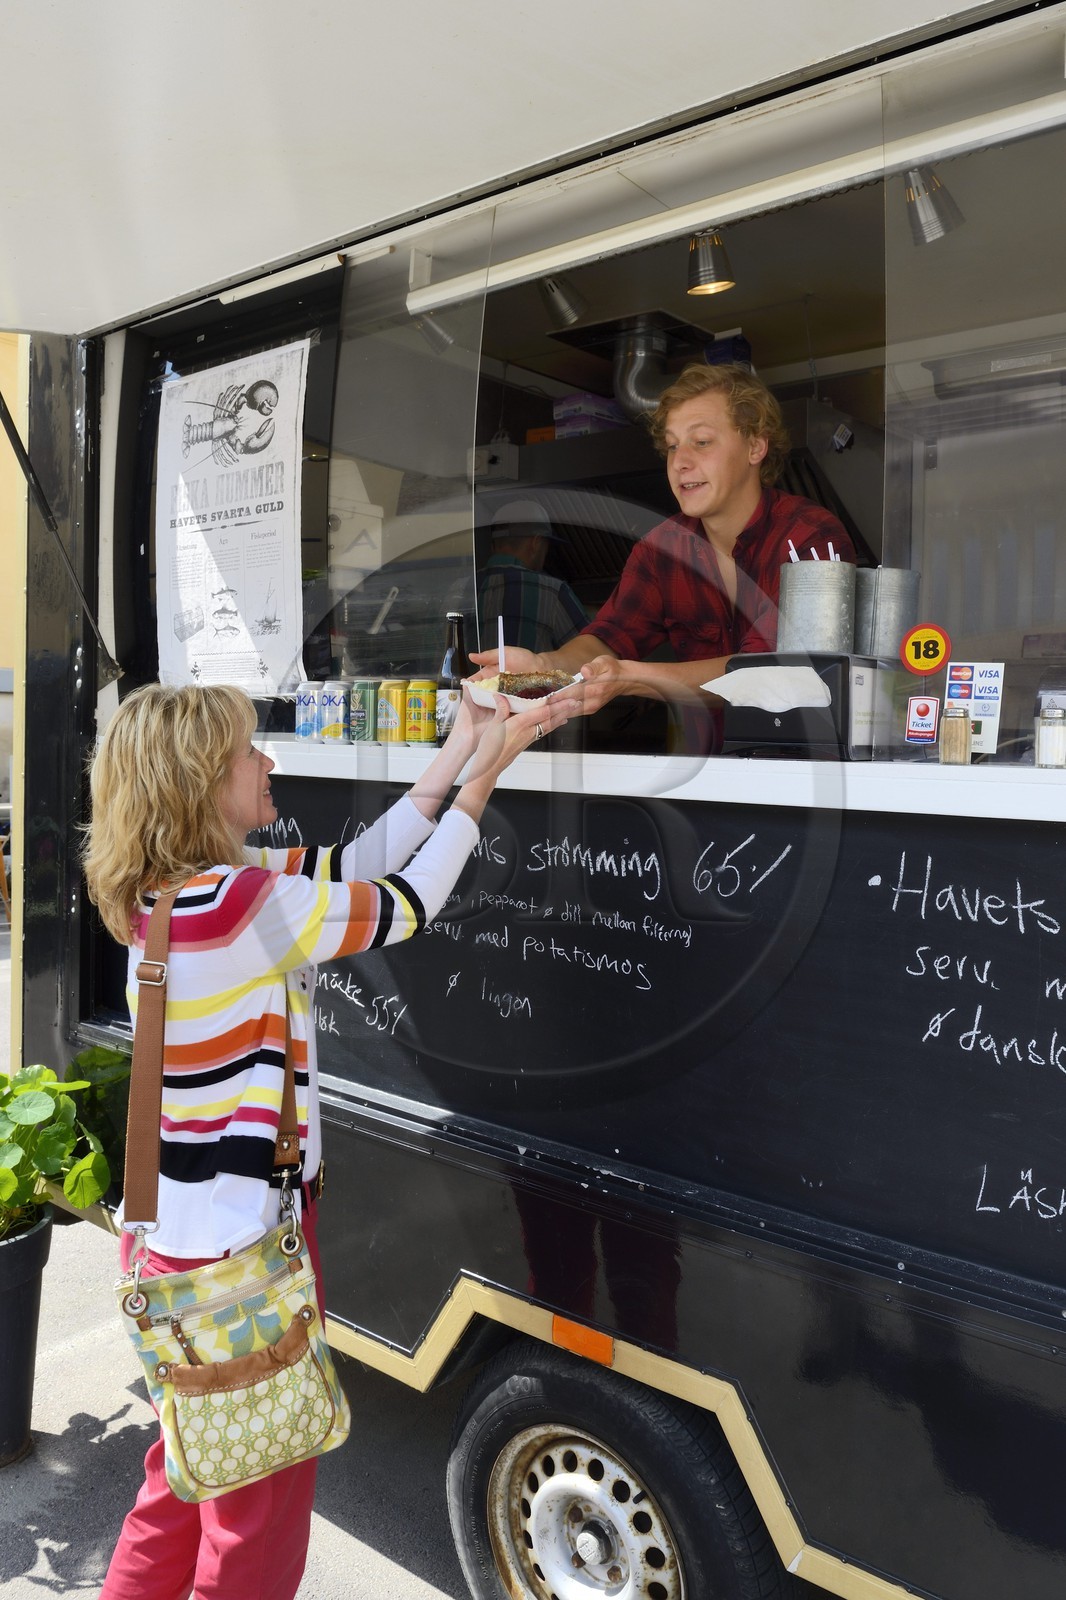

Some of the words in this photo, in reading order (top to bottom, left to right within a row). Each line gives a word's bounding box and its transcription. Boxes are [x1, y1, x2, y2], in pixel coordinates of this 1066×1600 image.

[169, 514, 208, 528] HAVETS
[211, 506, 252, 522] SVARTA
[255, 501, 284, 514] GULD
[912, 640, 940, 660] 18
[978, 670, 1000, 679] VISA
[977, 686, 999, 694] VISA
[911, 721, 932, 729] Ticket
[892, 850, 1060, 935] Havets
[560, 901, 582, 925] dill
[522, 935, 652, 991] potatismos
[481, 976, 532, 1018] lingon
